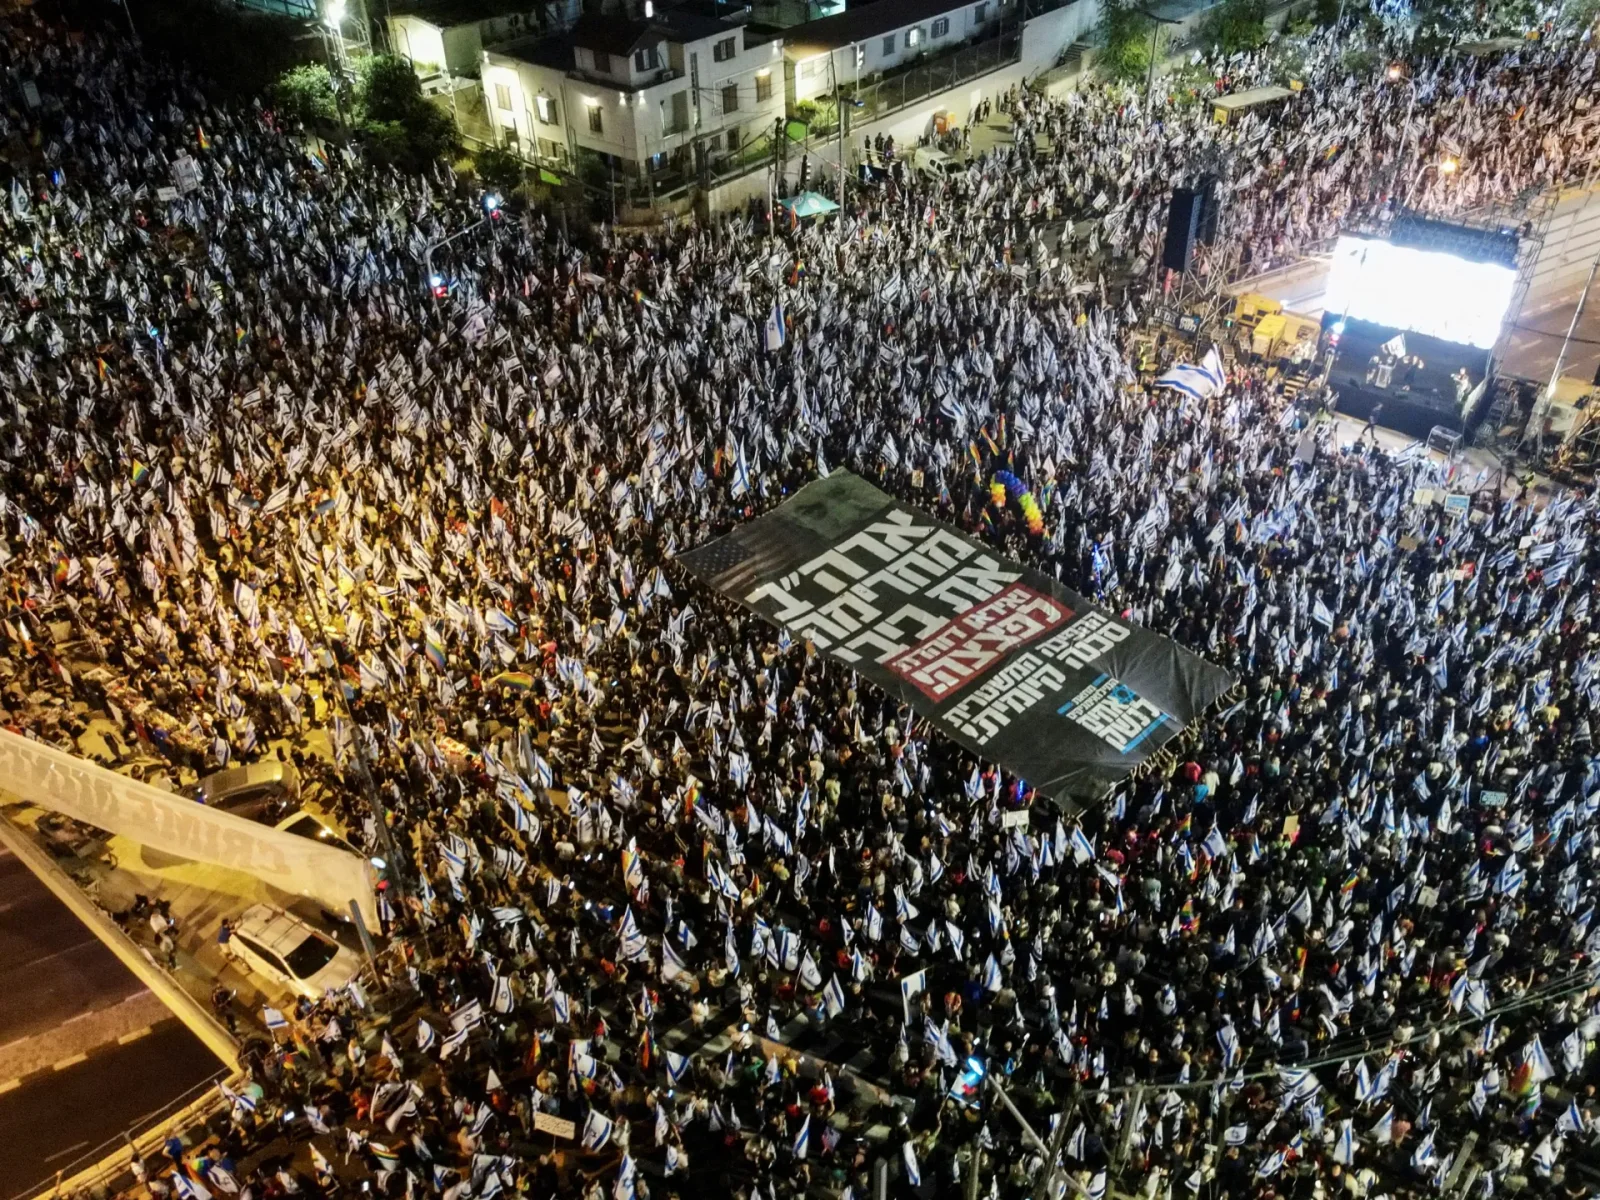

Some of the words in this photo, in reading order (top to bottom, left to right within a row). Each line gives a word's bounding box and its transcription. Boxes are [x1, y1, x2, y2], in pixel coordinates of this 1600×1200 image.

[744, 508, 935, 626] ארה"ב
[786, 528, 977, 650] מחרימה
[924, 554, 1023, 614] את
[830, 603, 951, 664] ביבי
[962, 588, 1032, 631] ואיראן
[1034, 610, 1108, 660] ההפיכה
[891, 625, 967, 677] דוהרת
[911, 593, 1062, 695] לפצצה!
[1056, 617, 1131, 670] סכנה
[941, 651, 1044, 728] המשטרית
[960, 662, 1066, 746] קיומית!
[1075, 695, 1134, 736] אחים
[1092, 696, 1161, 751] לנשק
